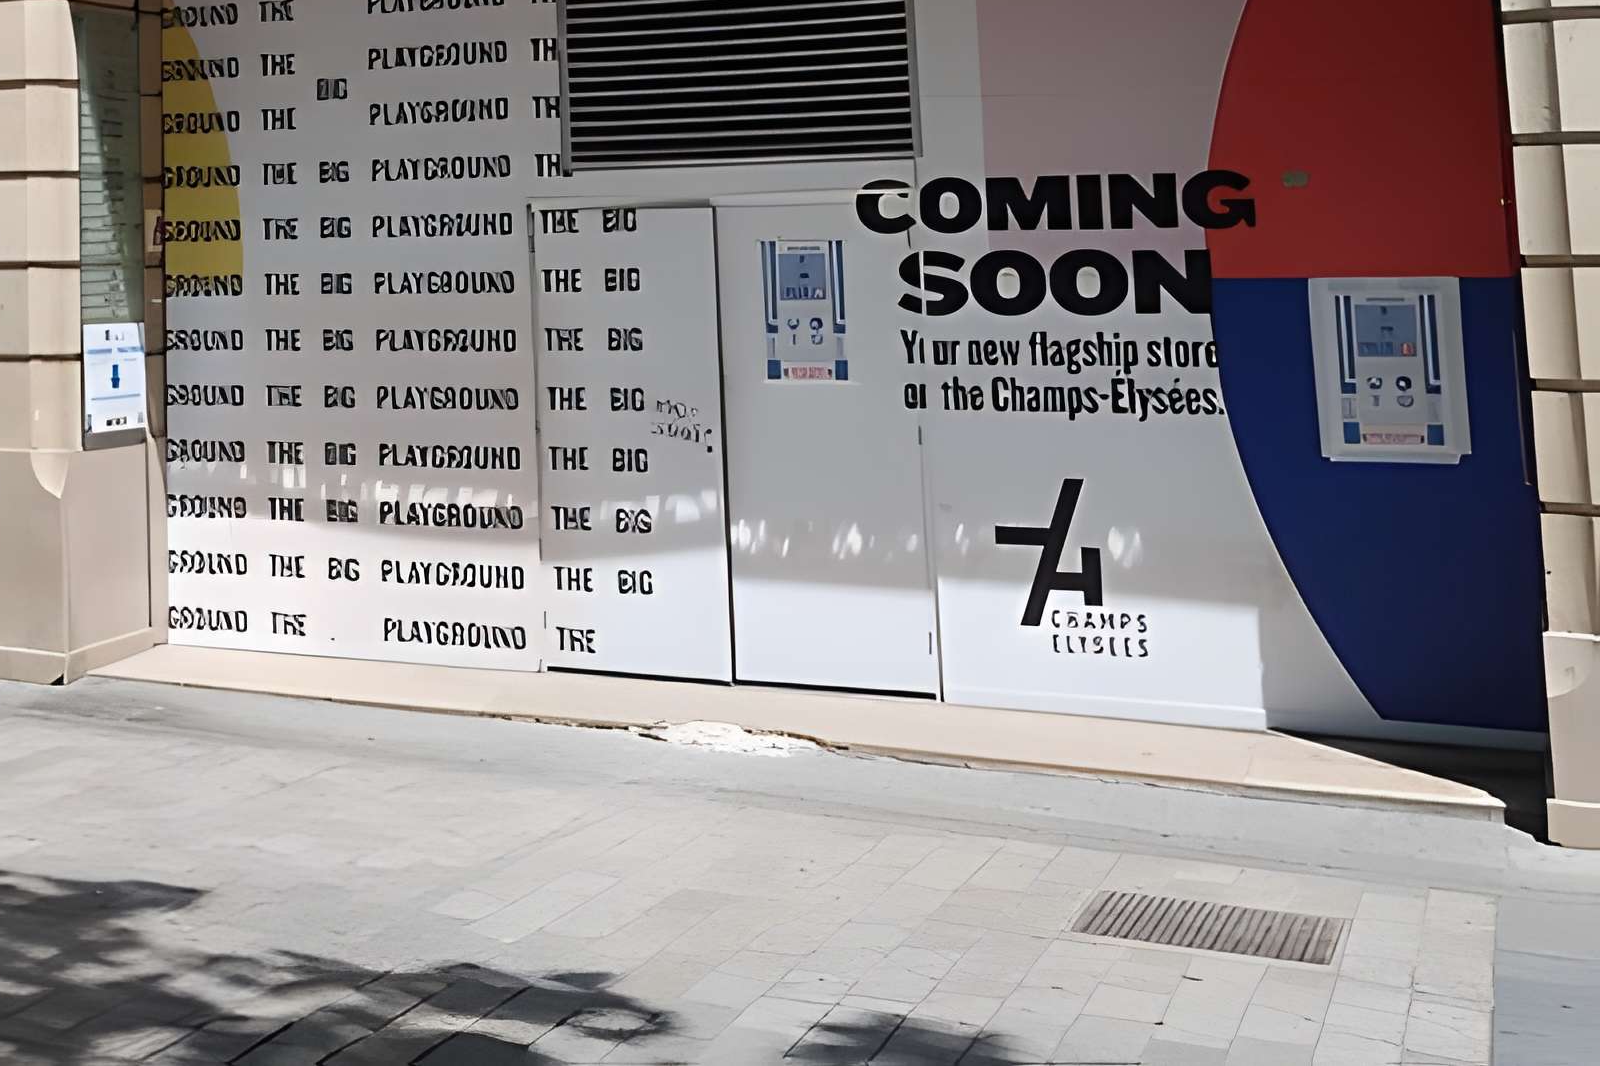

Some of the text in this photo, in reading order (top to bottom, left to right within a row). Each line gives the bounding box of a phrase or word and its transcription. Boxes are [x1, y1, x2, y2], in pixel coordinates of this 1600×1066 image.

[259, 0, 293, 22] THE
[261, 54, 295, 76] THE
[369, 41, 507, 69] PLAYGROUND
[262, 108, 296, 130] THE
[370, 98, 508, 125] PLAYGROUND
[264, 163, 296, 185] THE
[319, 161, 349, 183] BIG
[372, 155, 510, 181] PLAYGROUND
[855, 169, 1257, 234] COMING
[264, 218, 298, 240] THE
[321, 217, 351, 238] BIG
[373, 213, 512, 237] PLAYGROUND
[540, 210, 580, 234] THE
[603, 208, 636, 233] BIG
[265, 274, 299, 295] THE
[321, 273, 352, 294] BIG
[375, 271, 514, 294] PLAYGROUND
[544, 269, 581, 292] THE
[605, 268, 640, 291] BIG
[897, 248, 1213, 317] SOON
[266, 329, 300, 351] THE
[323, 329, 353, 351] BIG
[376, 329, 516, 352] PLAYGROUND
[545, 328, 583, 351] THE
[608, 328, 642, 351] BIG
[968, 339, 1020, 366] new
[1029, 331, 1139, 375] flagship
[1147, 336, 1219, 368] store
[267, 386, 301, 407] THE
[325, 386, 355, 408] BIG
[377, 386, 518, 410] PLAYGROUND
[548, 387, 586, 410] THE
[611, 388, 644, 411] BIG
[941, 376, 985, 411] the
[991, 369, 1225, 423] Champs-Élysées.
[268, 441, 303, 464] THE
[325, 442, 356, 465] BIG
[379, 444, 520, 470] PLAYGROUND
[549, 447, 588, 470] THE
[613, 448, 648, 472] BIG
[268, 498, 304, 521] THE
[327, 500, 357, 522] BIG
[380, 501, 523, 529] PLAYGROUND
[551, 506, 591, 530] THE
[616, 509, 651, 533] BIG
[270, 554, 304, 578] THE
[329, 558, 359, 581] BIG
[382, 560, 524, 589] PLAYGROUND
[555, 567, 592, 592] THE
[618, 570, 653, 594] BIG
[272, 612, 306, 636] THE
[384, 618, 526, 649] PLAYGROUND
[556, 627, 595, 653] THE
[1051, 609, 1148, 633] CHAMPS
